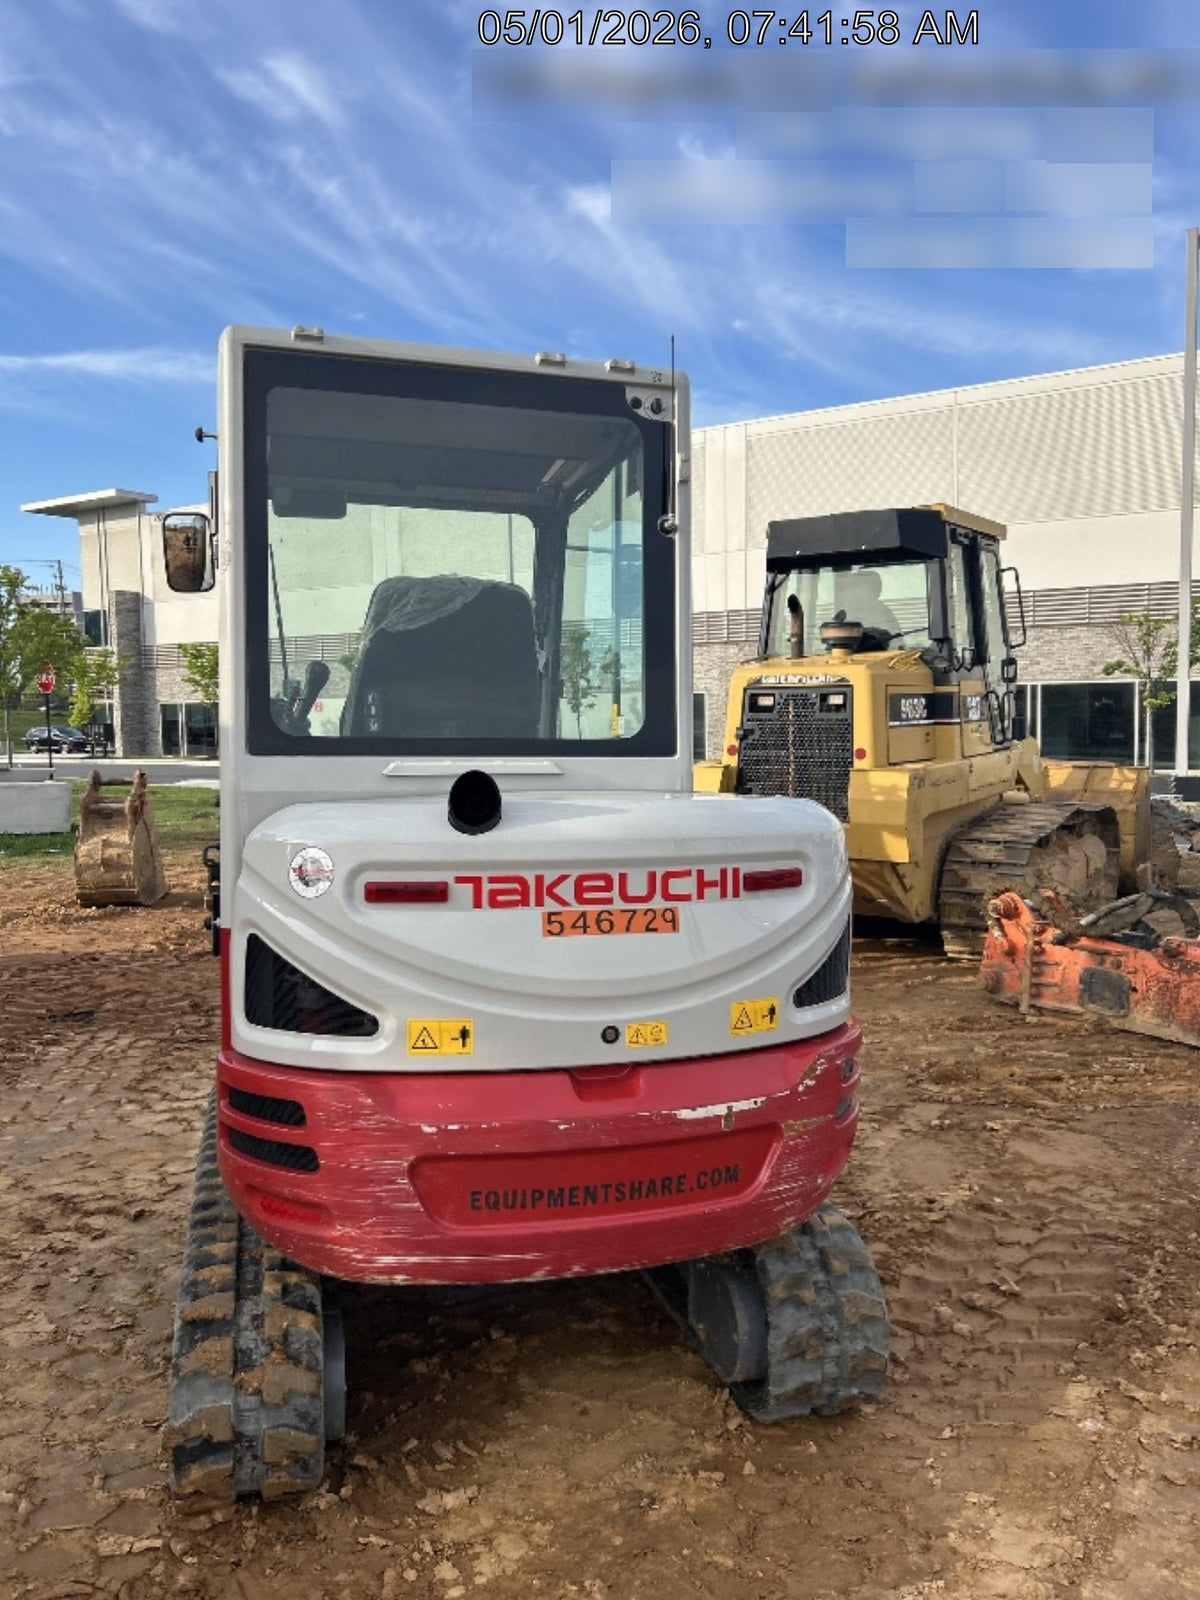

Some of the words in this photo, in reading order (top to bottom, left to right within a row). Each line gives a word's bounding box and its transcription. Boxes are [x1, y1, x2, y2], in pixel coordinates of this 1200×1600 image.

[454, 867, 740, 910] TAKEUCHI
[546, 908, 677, 936] 546729
[469, 1165, 740, 1211] EQUIPMENTSHARE.COM
